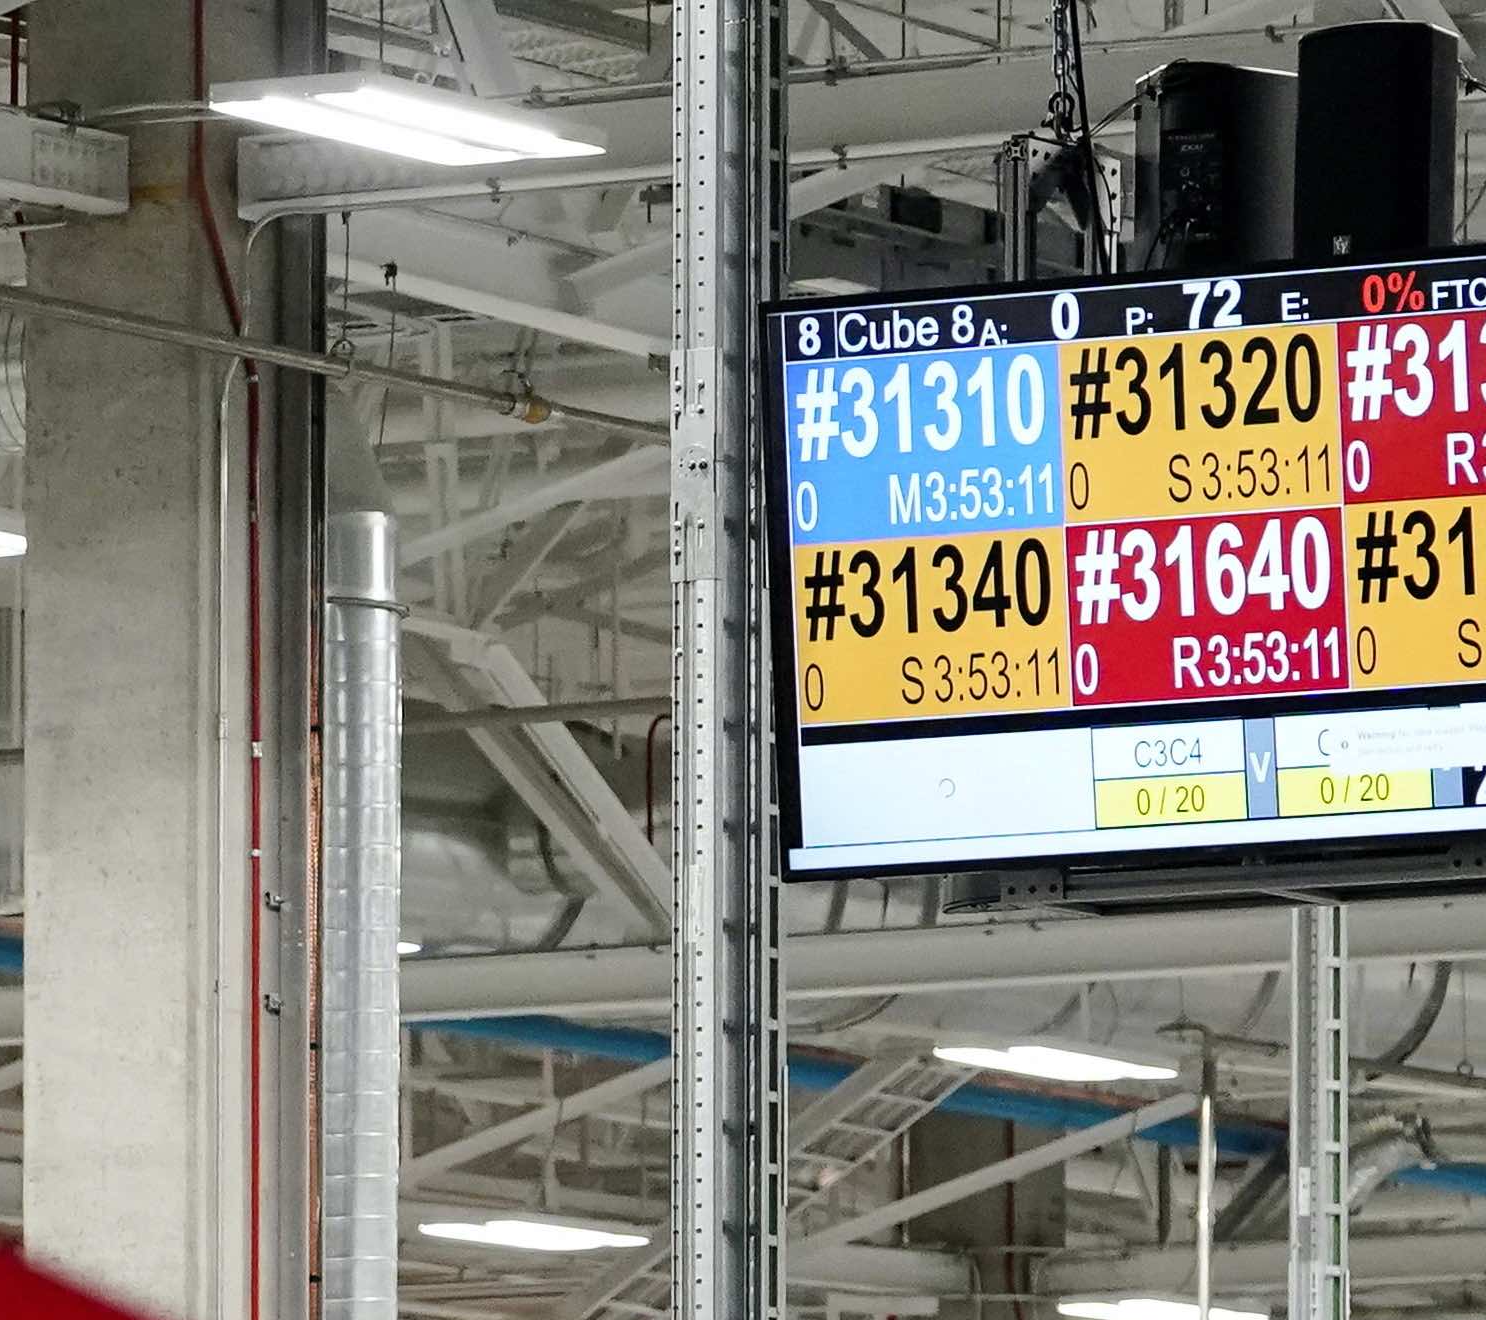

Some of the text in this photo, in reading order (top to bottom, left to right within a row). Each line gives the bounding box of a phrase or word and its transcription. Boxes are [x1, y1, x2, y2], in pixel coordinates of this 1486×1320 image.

[797, 316, 821, 356] 8
[838, 310, 939, 352] Cube
[951, 304, 975, 344] 8
[980, 318, 1008, 347] A:
[1051, 292, 1080, 340] 0
[1125, 307, 1154, 336] P:
[1182, 279, 1243, 330] 72
[1280, 291, 1310, 322] E:
[1361, 271, 1426, 314] 0%
[796, 353, 1047, 463] #31310
[1069, 332, 1322, 440] #31320
[1069, 460, 1091, 510] 0
[1346, 438, 1371, 493] 0
[795, 478, 819, 532] 0
[803, 538, 1051, 643] #31340
[1075, 514, 1332, 627] #31640
[1075, 643, 1099, 696] 0
[1357, 626, 1378, 675] 0
[803, 663, 825, 712] 0
[1133, 738, 1204, 769] C3C4
[1250, 750, 1272, 784] V
[1136, 788, 1155, 817] 0
[1174, 783, 1206, 815] 20
[1320, 776, 1335, 804] 0
[1359, 773, 1390, 802] 20
